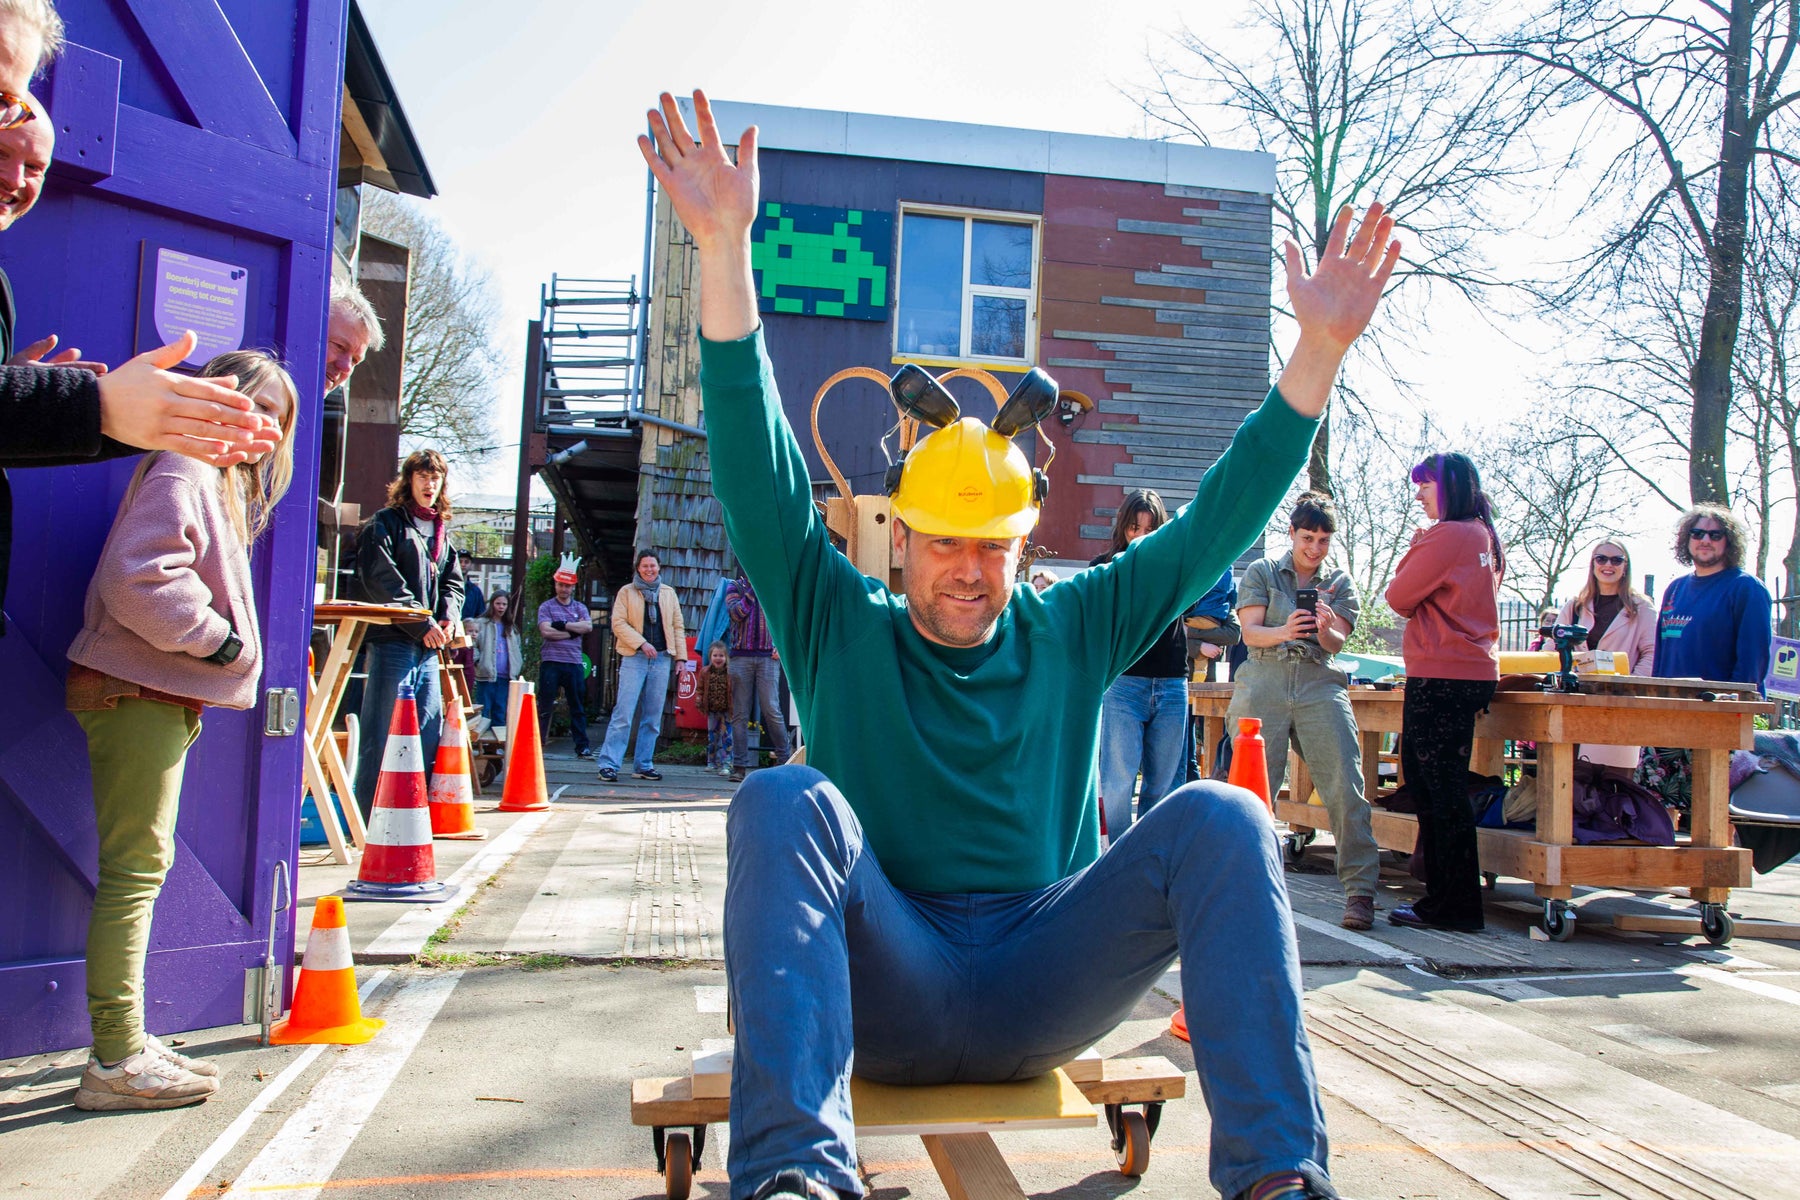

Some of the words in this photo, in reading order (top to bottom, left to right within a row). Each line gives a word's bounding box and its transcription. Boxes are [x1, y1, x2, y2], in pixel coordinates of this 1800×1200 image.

[166, 271, 200, 288] Boerderij
[168, 285, 198, 299] opening
[1778, 650, 1796, 664] UP
